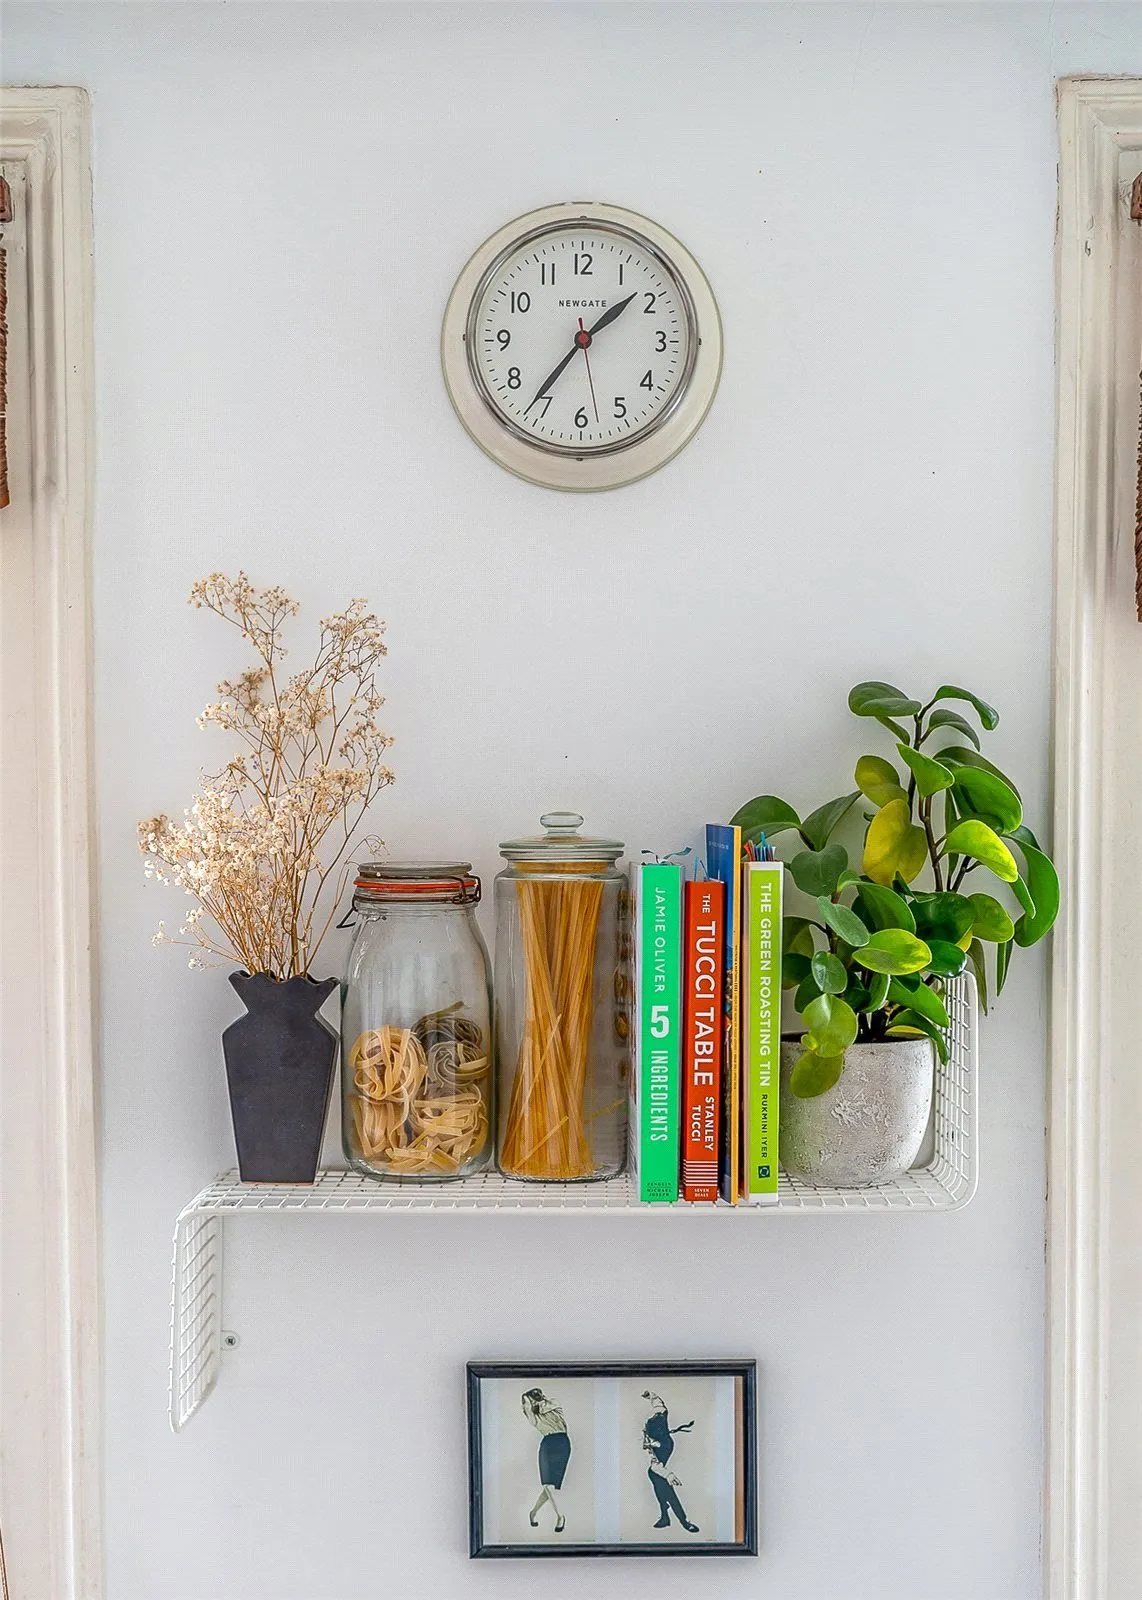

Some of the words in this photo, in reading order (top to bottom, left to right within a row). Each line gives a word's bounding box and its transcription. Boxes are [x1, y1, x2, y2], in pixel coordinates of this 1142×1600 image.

[541, 263, 556, 285] 11
[574, 253, 593, 275] 12
[618, 263, 624, 285] 1
[510, 291, 531, 313] 10
[558, 299, 608, 308] NEWGATE
[643, 292, 656, 314] 2
[496, 329, 511, 351] 9
[655, 330, 667, 352] 3
[507, 366, 522, 389] 8
[639, 369, 653, 391] 4
[540, 395, 553, 418] 7
[574, 406, 588, 428] 6
[613, 396, 627, 418] 5
[701, 893, 711, 914] THE
[760, 882, 772, 913] THE
[655, 887, 666, 932] JAMIE
[760, 917, 772, 971] GREEN
[654, 937, 666, 993] OLIVER
[695, 920, 716, 999] TUCCI
[650, 1005, 670, 1039] 5
[759, 976, 772, 1056] ROASTING
[693, 1006, 715, 1086] TABLE
[759, 1061, 771, 1087] TIN
[650, 1050, 669, 1142] INGREDIENTS
[691, 1104, 701, 1142] TUCCI
[704, 1096, 715, 1152] STANLEY
[760, 1094, 768, 1135] RUKMINI
[760, 1136, 768, 1158] IYER
